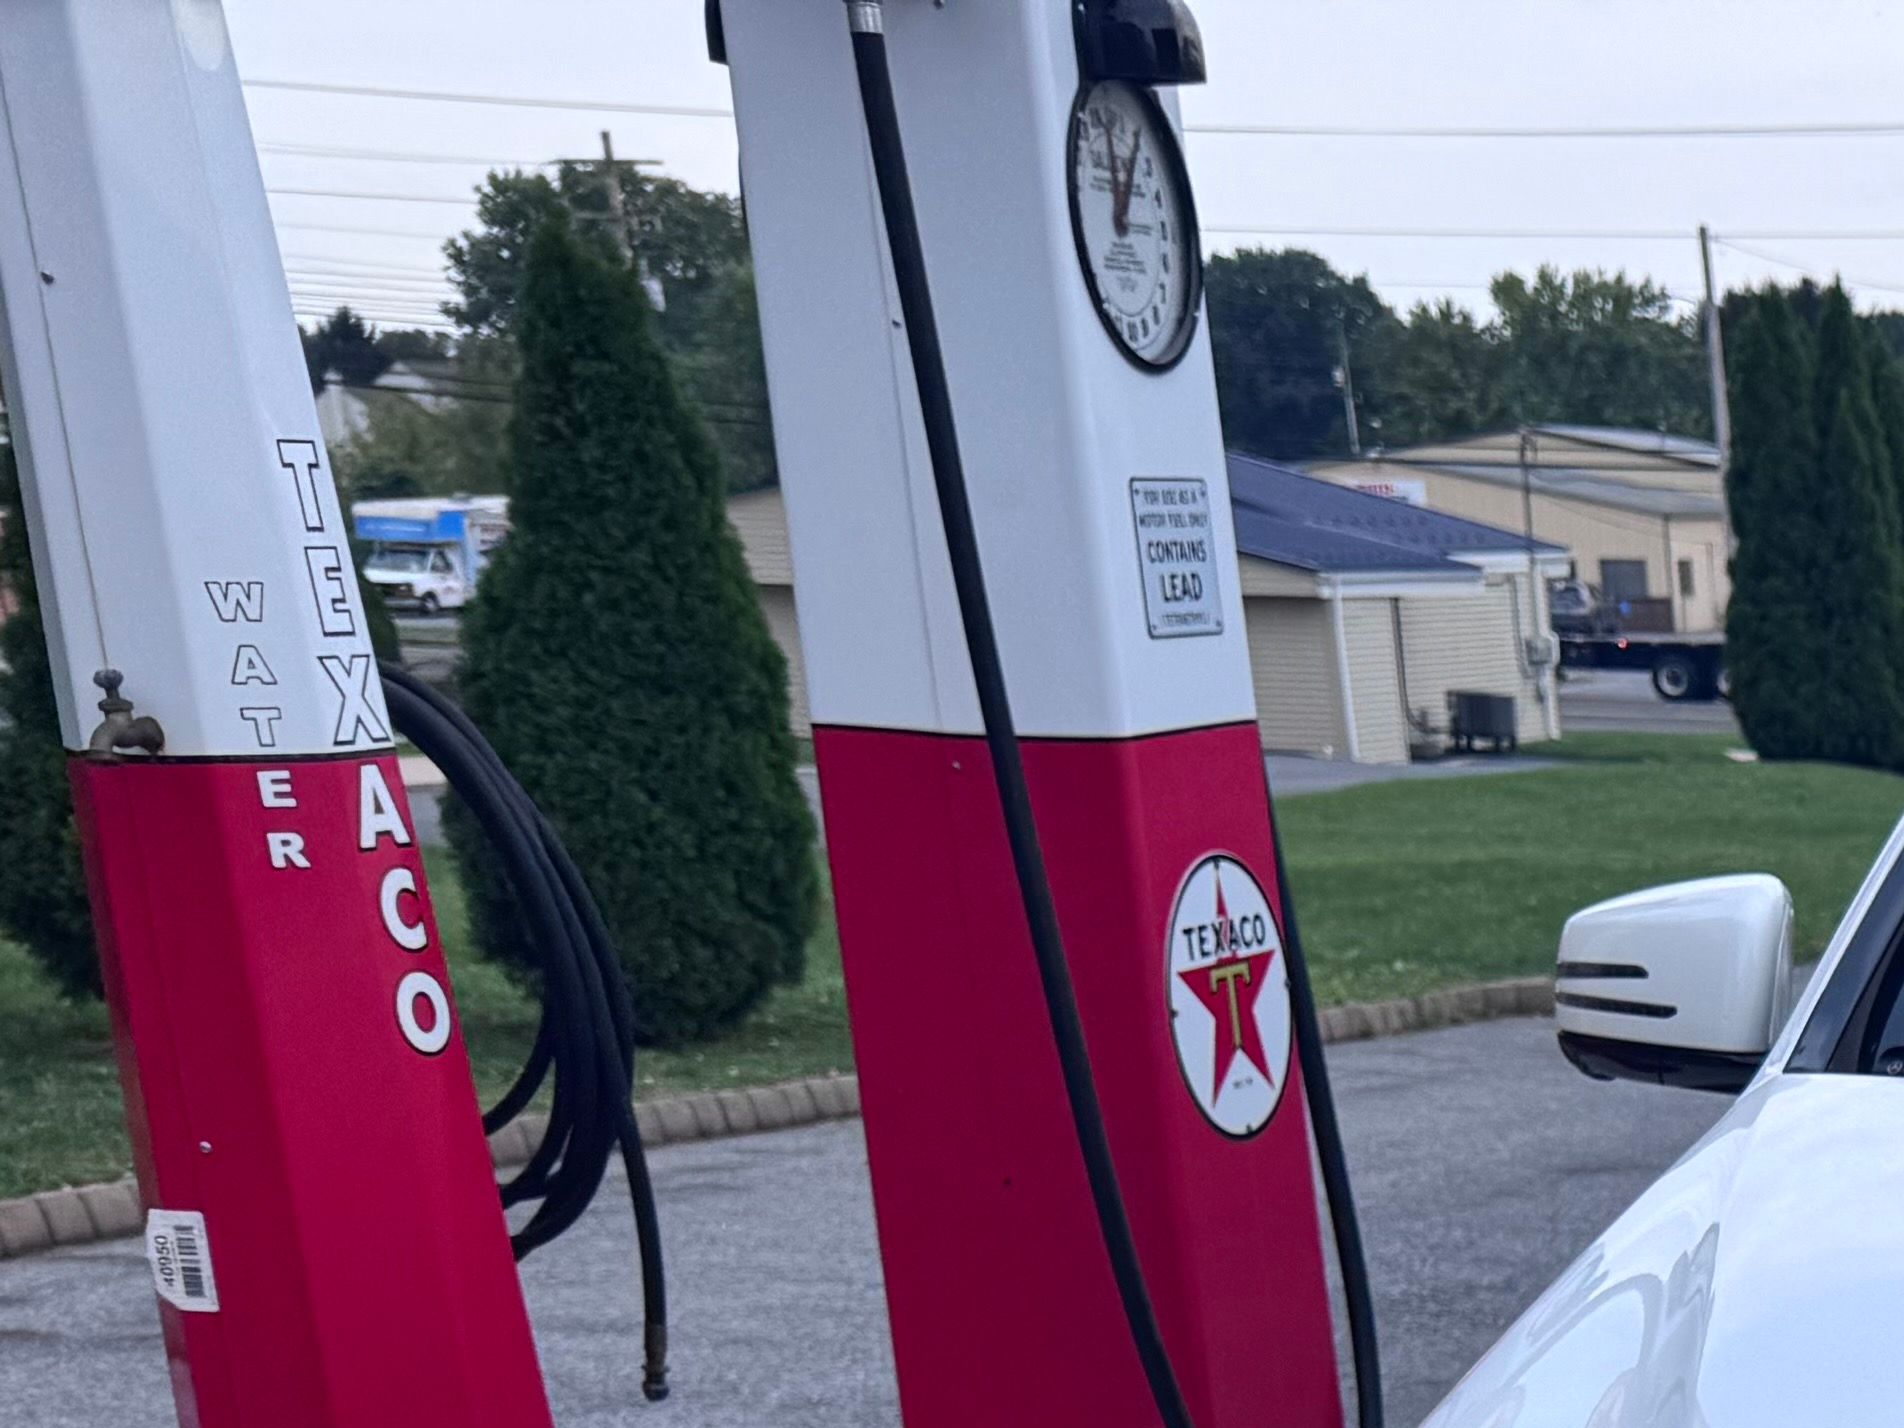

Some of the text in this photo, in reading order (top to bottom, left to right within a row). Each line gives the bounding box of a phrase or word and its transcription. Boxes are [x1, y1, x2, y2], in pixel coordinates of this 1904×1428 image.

[1148, 539, 1208, 564] CONTAINS
[1160, 571, 1204, 603] LEAD
[204, 581, 311, 868] WATER
[276, 439, 451, 1056] TEXACO
[1182, 914, 1266, 961] TEXACO
[1210, 963, 1252, 1050] T
